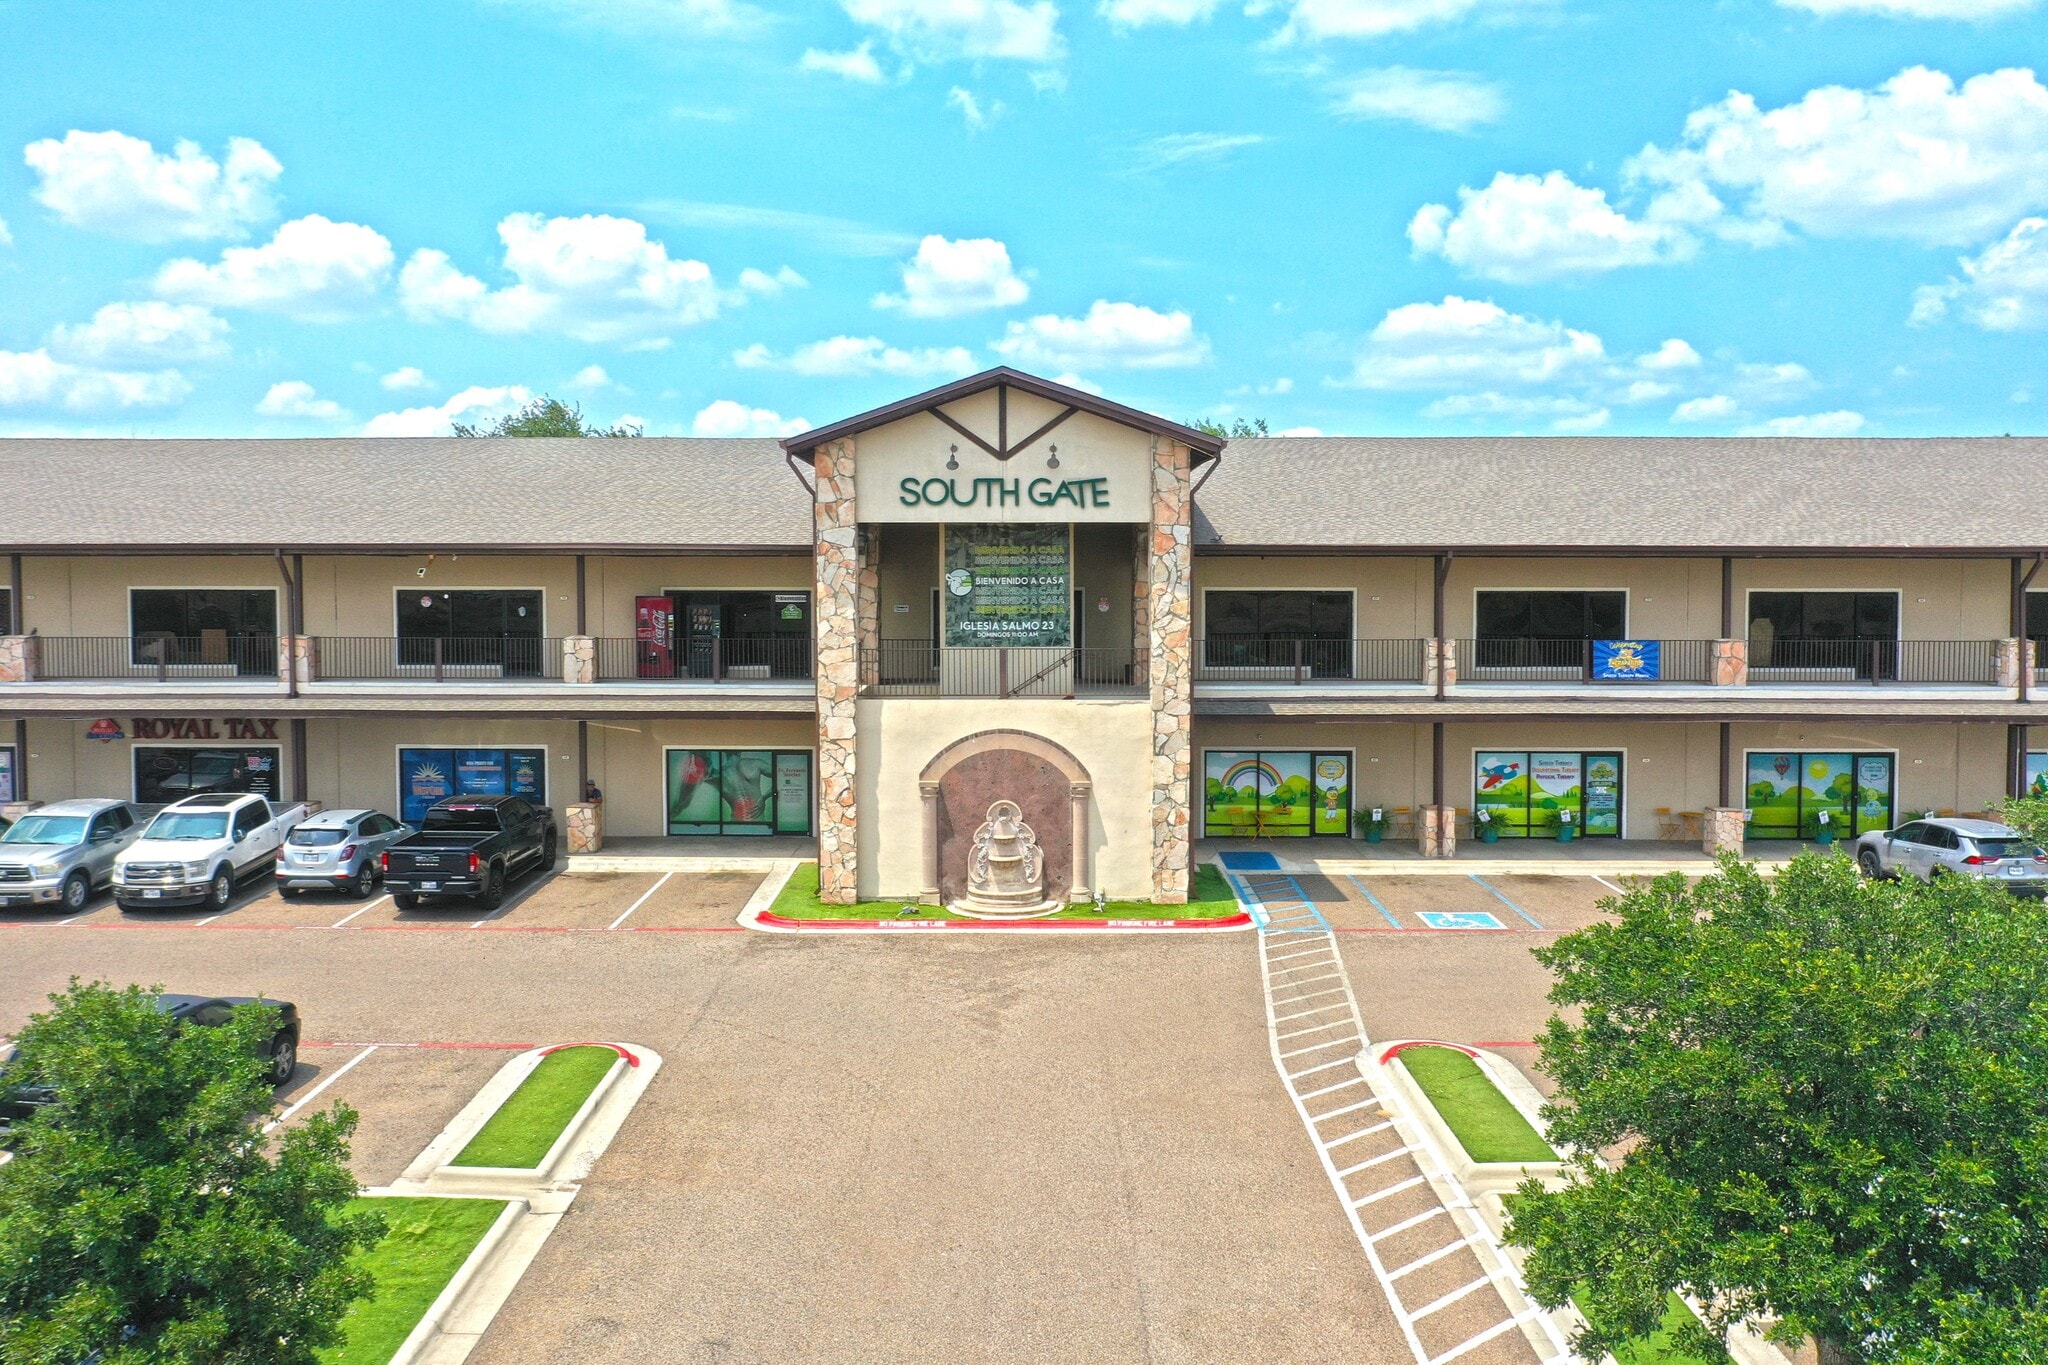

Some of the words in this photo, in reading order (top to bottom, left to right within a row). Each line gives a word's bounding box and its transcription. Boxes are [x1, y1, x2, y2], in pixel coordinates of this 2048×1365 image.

[899, 477, 1020, 507] SOUTH
[1027, 477, 1110, 509] GATE
[975, 577, 1029, 585] BIENVENIDO
[1030, 577, 1038, 585] A
[1038, 577, 1065, 585] CASA
[960, 621, 1000, 630] IGLESIA
[1002, 620, 1040, 630] SALMO
[1042, 620, 1054, 630] 23
[131, 718, 220, 740] ROYAL
[224, 718, 280, 740] TAX
